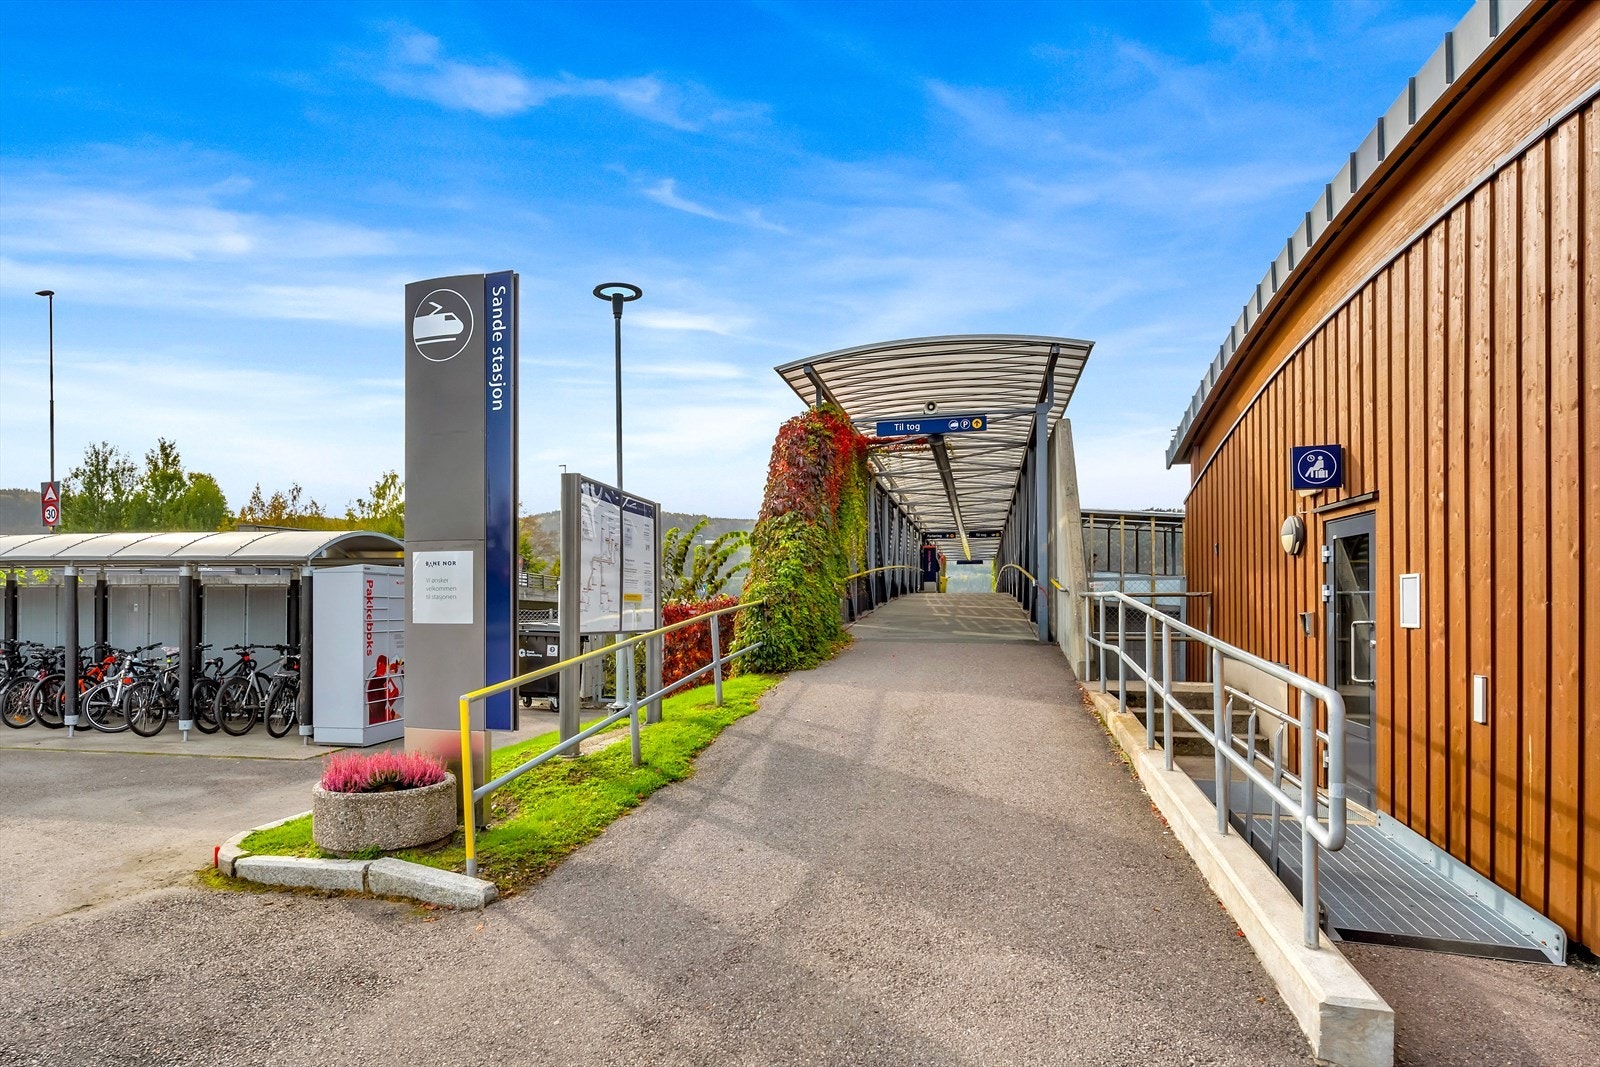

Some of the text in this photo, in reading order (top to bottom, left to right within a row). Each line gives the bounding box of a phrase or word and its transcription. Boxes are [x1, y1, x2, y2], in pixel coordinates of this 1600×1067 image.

[488, 285, 507, 411] Sande stasjon
[894, 423, 904, 431] Til
[906, 423, 921, 432] tog
[46, 509, 56, 519] 30
[366, 579, 374, 656] Pakkeboks
